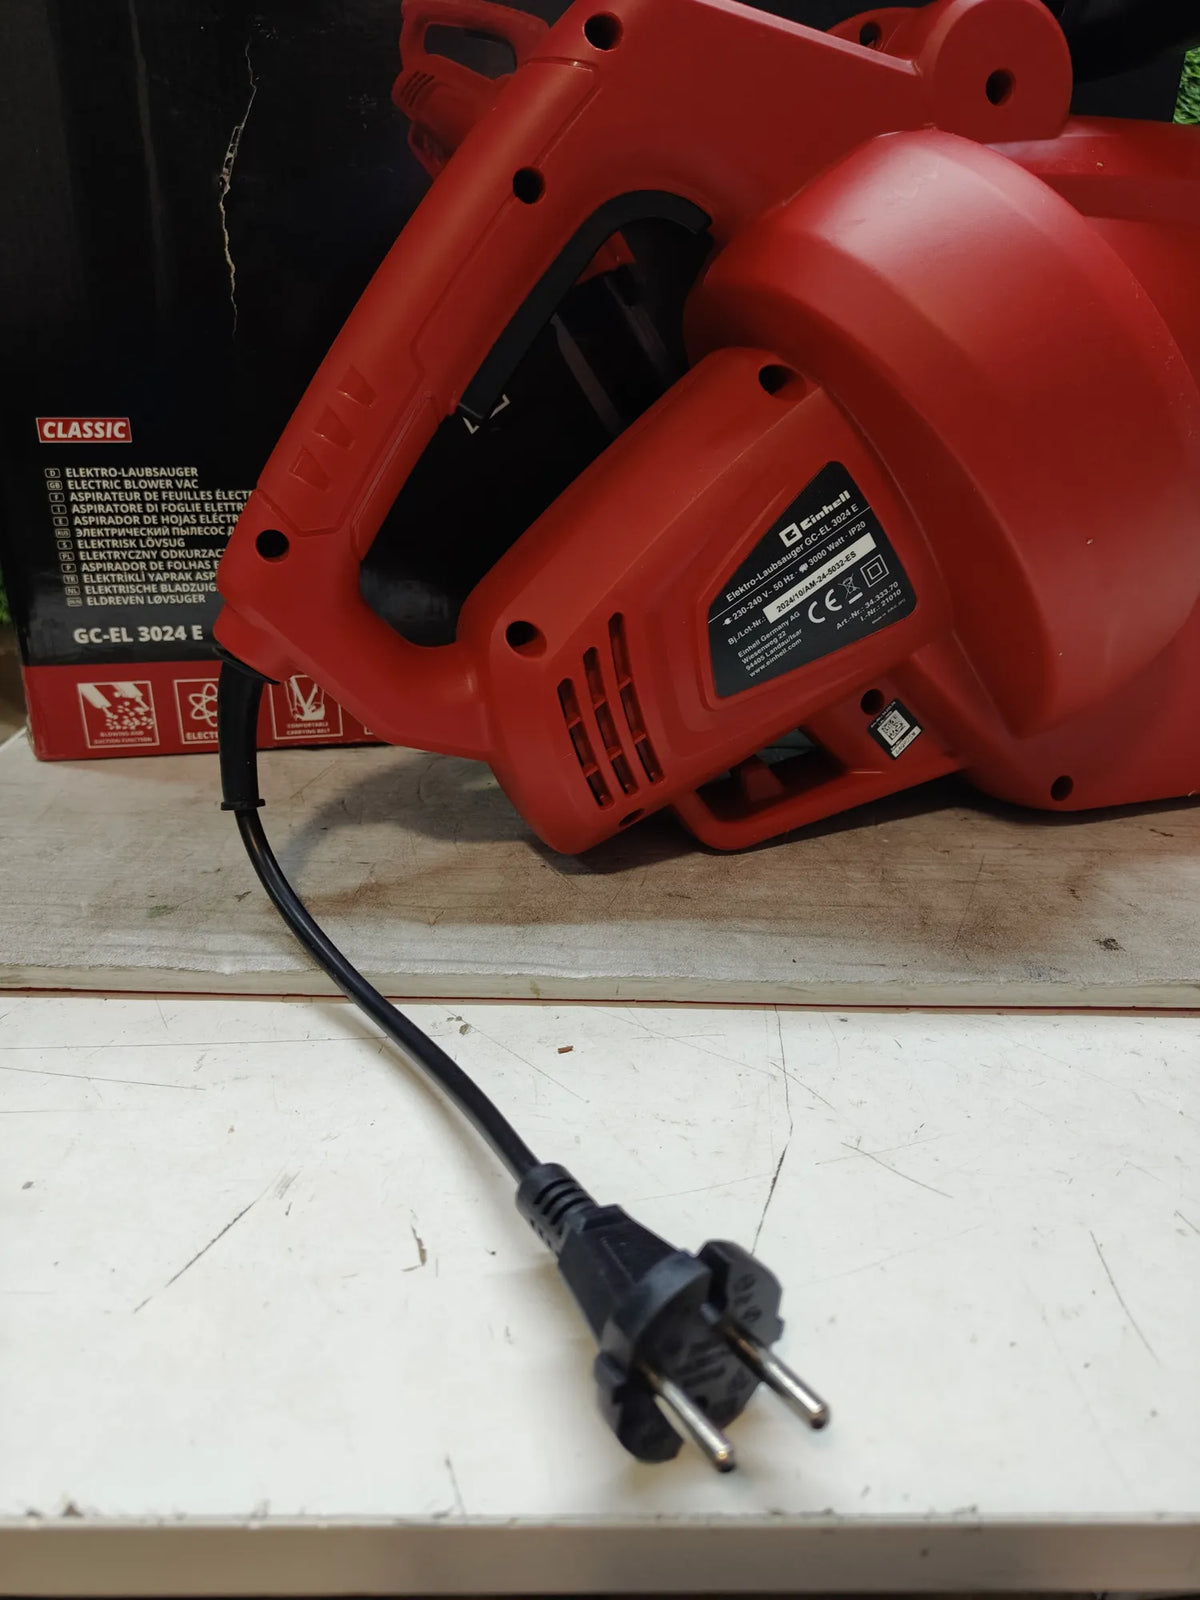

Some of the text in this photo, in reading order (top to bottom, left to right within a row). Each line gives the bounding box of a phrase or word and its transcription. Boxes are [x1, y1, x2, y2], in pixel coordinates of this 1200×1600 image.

[43, 421, 126, 439] CLASSIC
[65, 467, 199, 478] ELEKTRO-LAUBSAUGER
[67, 480, 121, 490] ELECTRIC
[124, 479, 173, 489] BLOWER
[175, 479, 199, 489] VAC
[70, 491, 142, 502] ASPIRATEUR
[144, 491, 159, 501] DE
[161, 490, 213, 501] FEUILLES
[72, 503, 144, 514] ASPIRATORE
[146, 503, 159, 513] DI
[161, 503, 202, 513] FOGLIE
[799, 490, 852, 531] Einhell
[73, 515, 141, 526] ASPIRADOR
[143, 515, 159, 525] DE
[161, 515, 197, 526] HOJAS
[75, 526, 170, 537] ЭЛЕКТРИЧЕСКИЙ
[77, 540, 137, 549] ELEKTRISK
[140, 537, 185, 548] LÖVSUG
[79, 550, 158, 560] ELEKTRYCZNY
[725, 503, 859, 602] Elektro-Laubsauger GC-EL 3024 E
[81, 561, 148, 572] ASPIRADOR
[149, 561, 165, 571] DE
[167, 560, 211, 570] FOLHAS
[732, 595, 763, 620] 230-240
[772, 579, 784, 591] 50
[783, 572, 795, 584] Hz
[807, 548, 828, 566] 3000
[826, 535, 846, 552] Watt
[848, 520, 867, 537] IP20
[147, 572, 193, 582] YAPRAK
[195, 571, 218, 581] ASP
[775, 550, 857, 613] 2024/10/AM-24-5032-ES
[84, 584, 158, 595] ELEKTRISCHE
[160, 583, 219, 593] BLADZUIG
[864, 581, 900, 609] 34.333.70
[86, 595, 145, 606] ELDREVEN
[880, 588, 902, 606] 21010
[73, 625, 204, 644] GC-EL 3024 E
[737, 610, 801, 658] Einhell Germany AG
[741, 630, 787, 664] Wiesenweg 22
[749, 638, 803, 678] www.einhell.com
